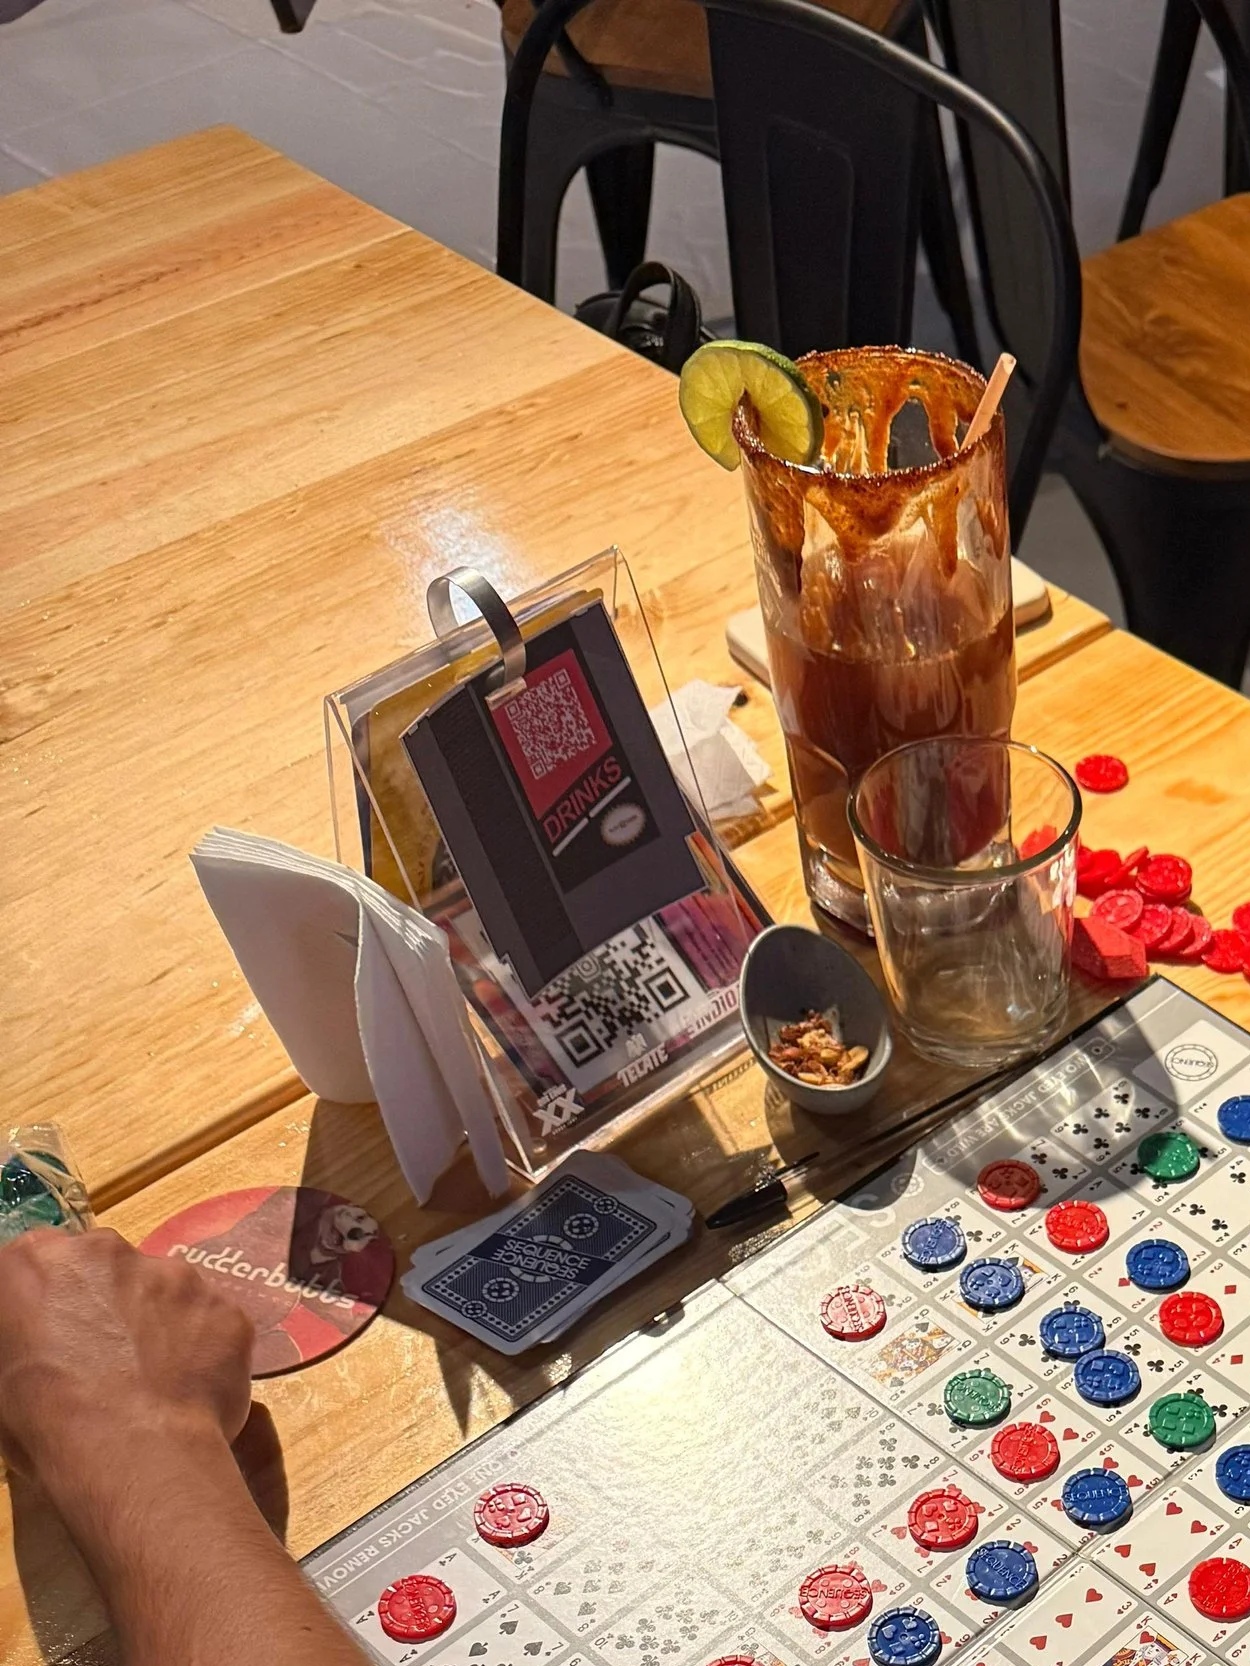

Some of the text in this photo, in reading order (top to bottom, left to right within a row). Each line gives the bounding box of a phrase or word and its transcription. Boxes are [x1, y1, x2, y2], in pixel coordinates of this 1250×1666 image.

[542, 756, 622, 844] DRINKS
[617, 1043, 669, 1087] TECATE
[533, 1088, 584, 1137] XX
[491, 1248, 579, 1280] SEQUENCE
[504, 1239, 591, 1270] SEQUENCE
[167, 1244, 359, 1309] rudderbutts
[433, 1481, 472, 1512] EYED
[378, 1509, 430, 1548] JACKS
[976, 1547, 1027, 1589] SEQUENCE
[507, 1604, 519, 1613] 7
[551, 1642, 564, 1651] 7
